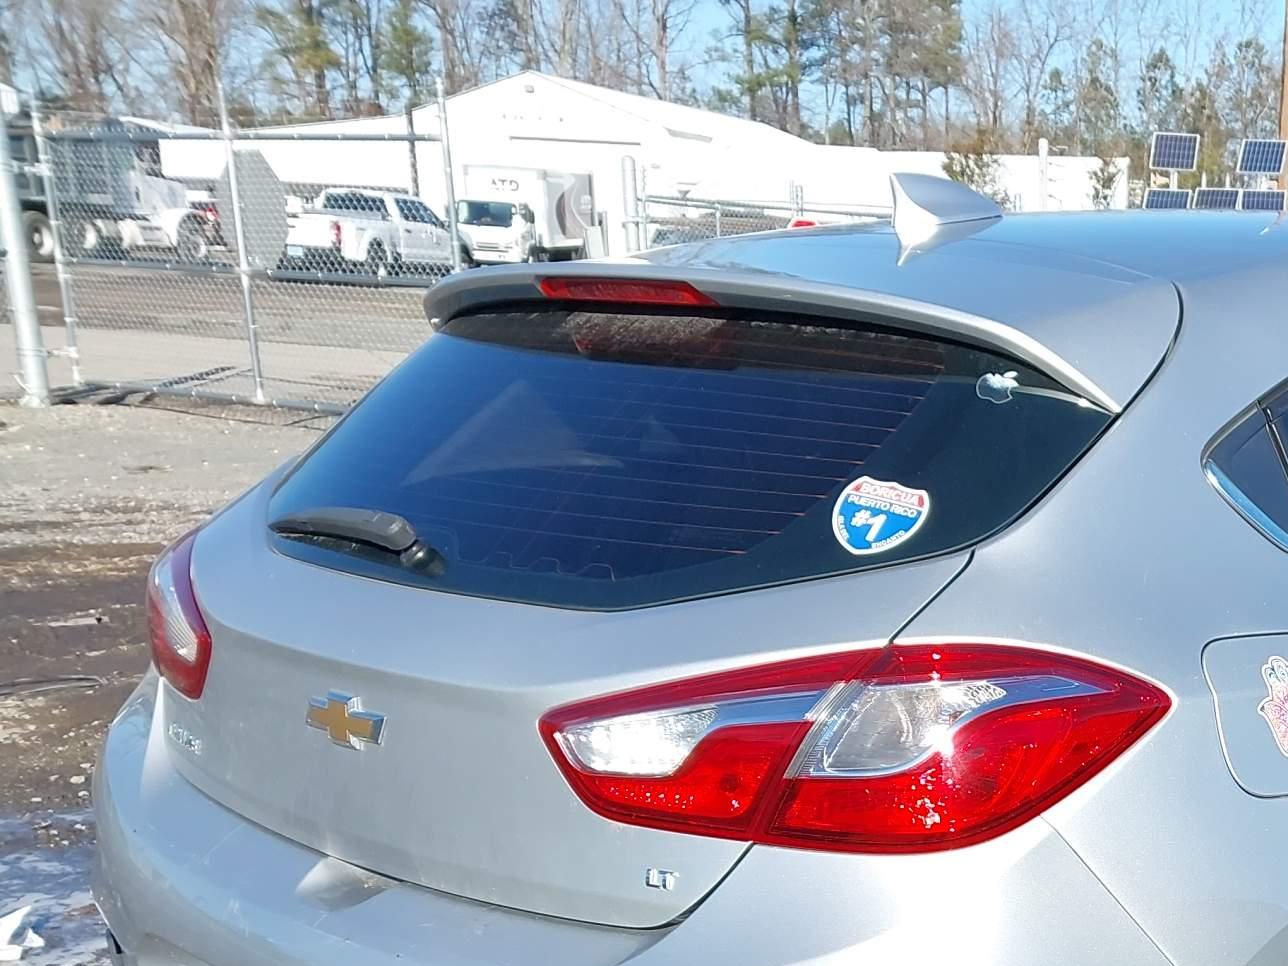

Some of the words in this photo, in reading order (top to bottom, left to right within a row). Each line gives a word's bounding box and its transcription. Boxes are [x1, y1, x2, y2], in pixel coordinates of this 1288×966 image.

[848, 494, 890, 511] PUERTO
[889, 504, 918, 518] RICO
[859, 482, 919, 507] BORICUA
[850, 509, 887, 542] #1
[645, 867, 680, 891] LT
